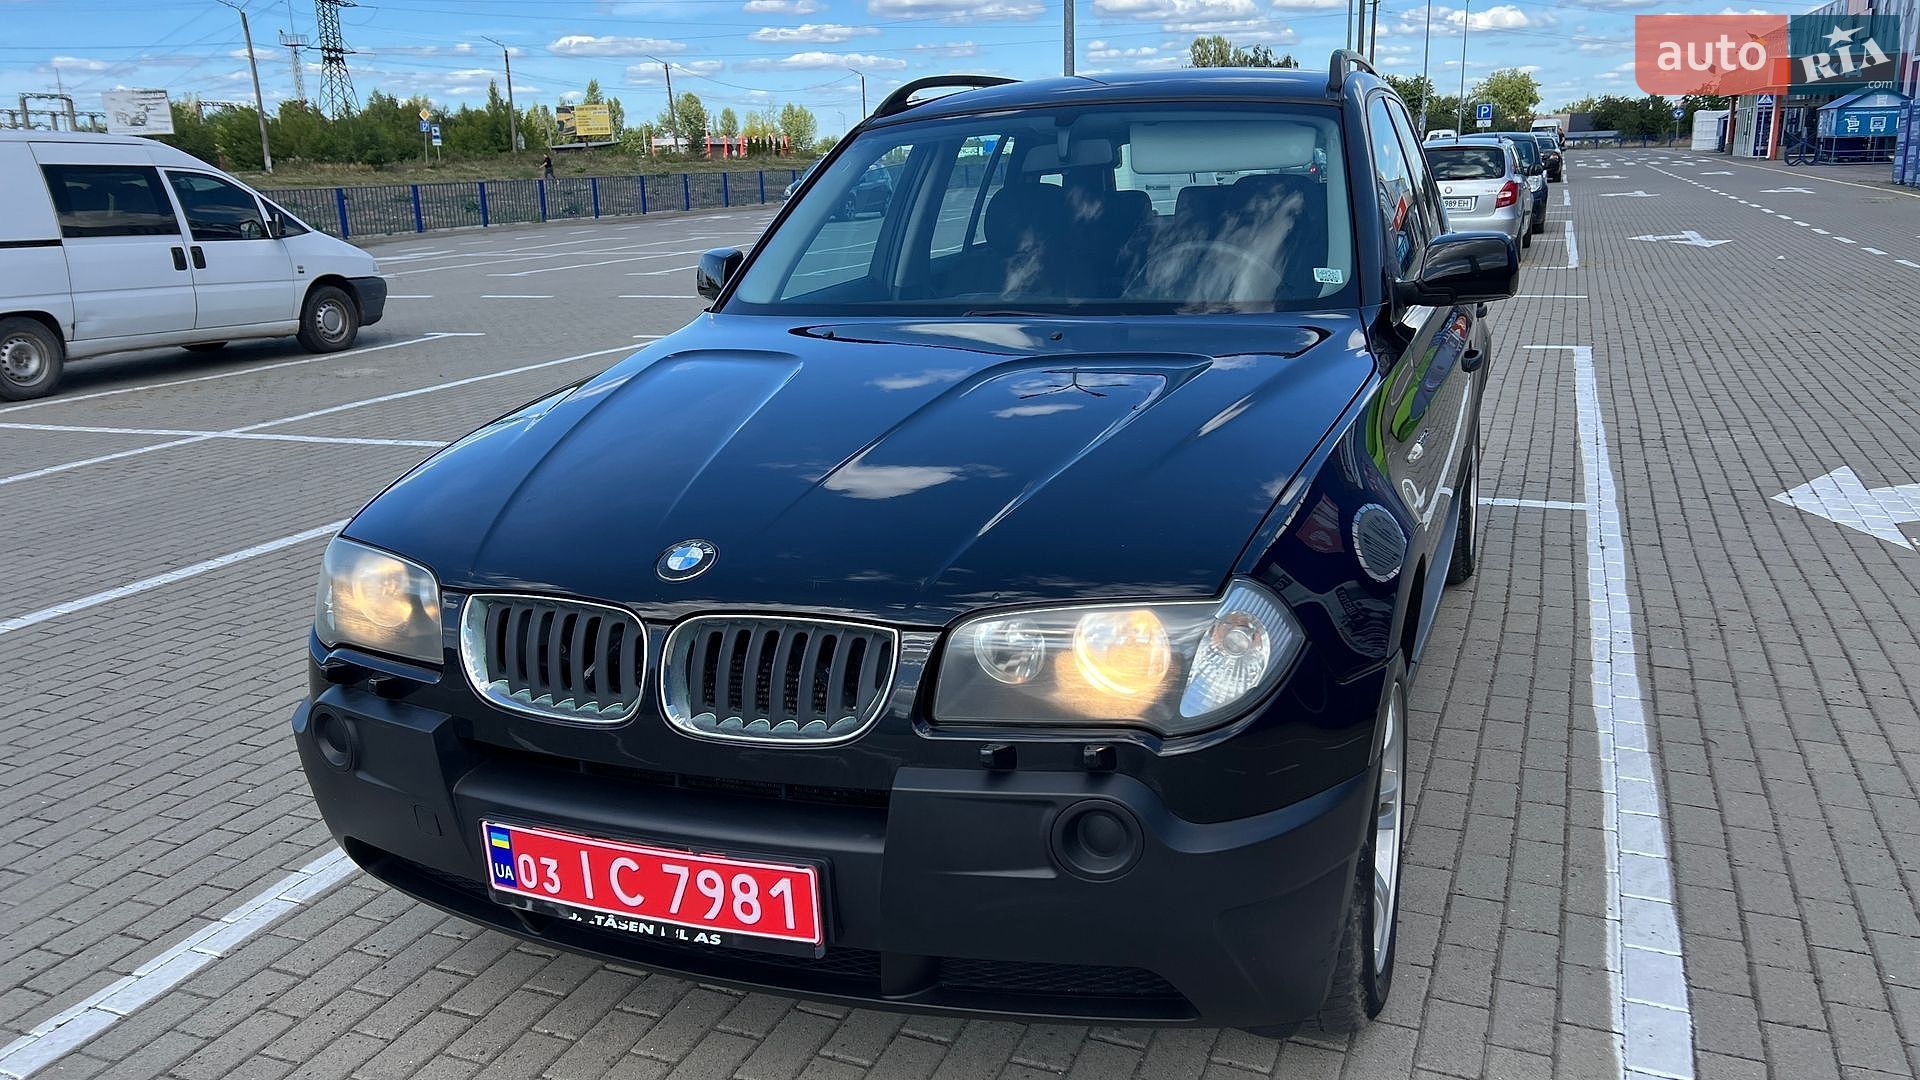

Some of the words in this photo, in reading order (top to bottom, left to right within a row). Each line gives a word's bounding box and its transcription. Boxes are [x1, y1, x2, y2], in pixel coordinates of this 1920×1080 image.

[1481, 106, 1489, 117] P
[495, 862, 514, 880] UA
[518, 853, 561, 894] 03
[661, 863, 796, 930] 7981
